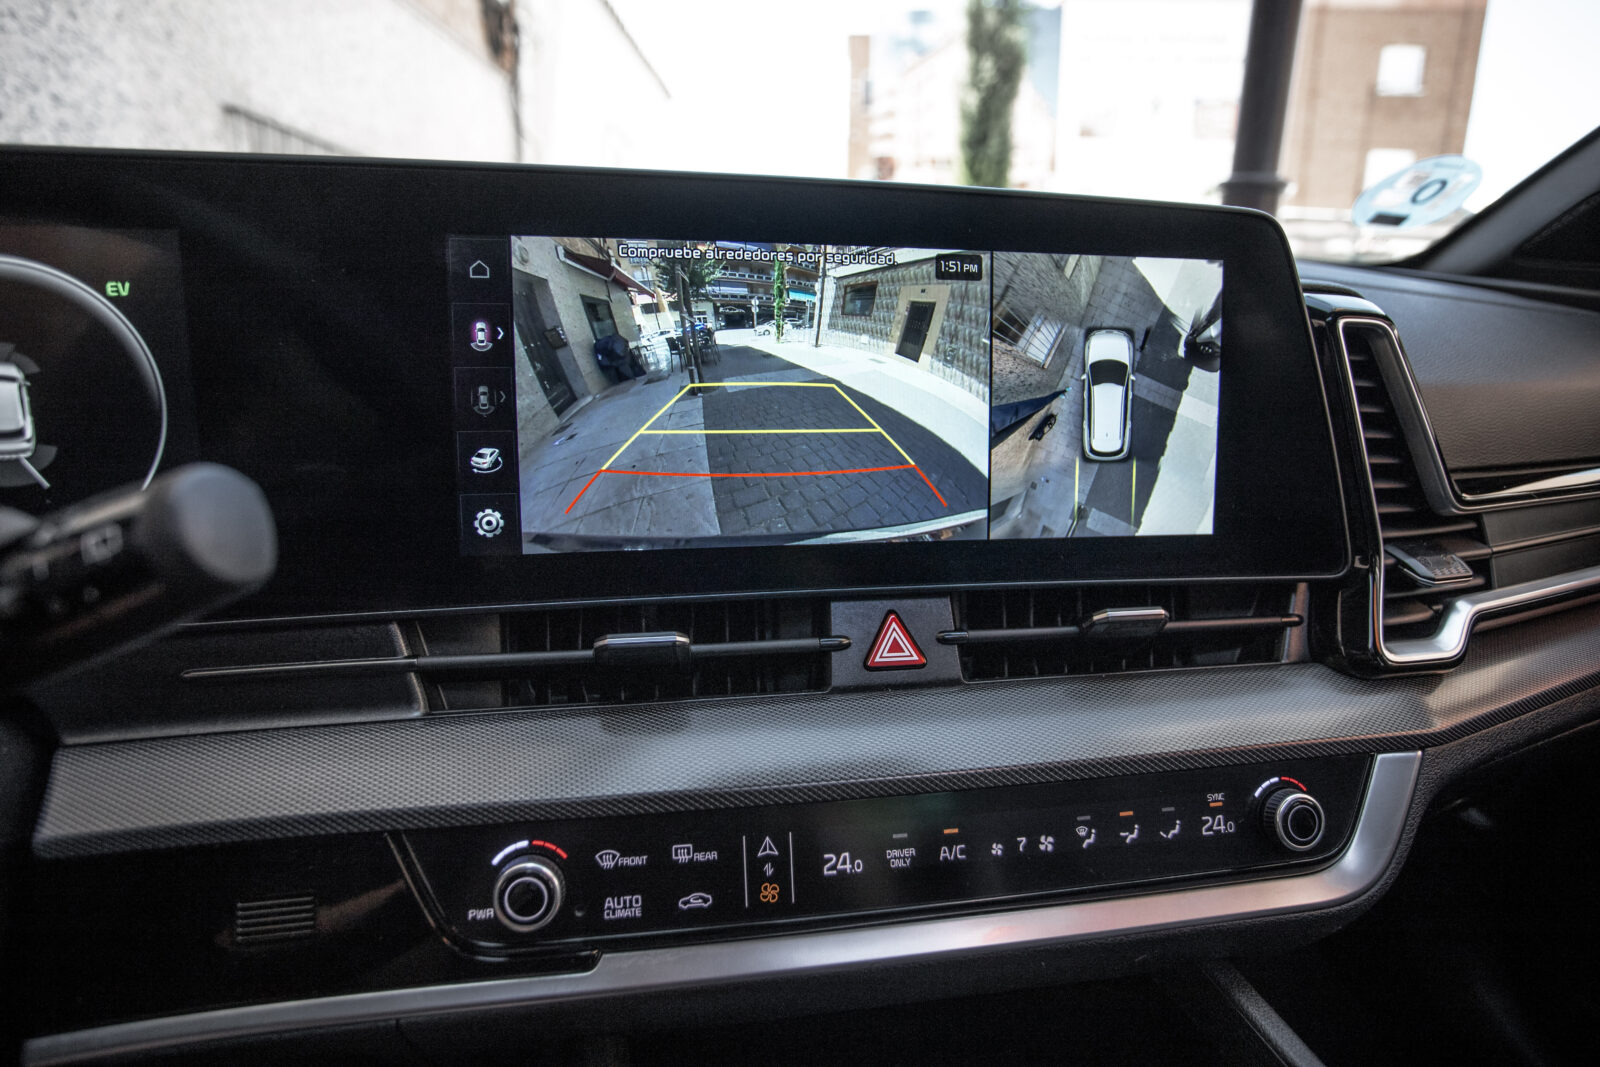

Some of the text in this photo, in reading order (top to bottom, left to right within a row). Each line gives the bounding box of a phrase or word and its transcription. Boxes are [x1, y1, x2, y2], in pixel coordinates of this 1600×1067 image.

[618, 244, 898, 266] Compruebe alrededores por seguridad.
[940, 260, 979, 274] 1:51 PM
[105, 280, 130, 297] EV
[1206, 792, 1225, 802] SYNC
[1201, 814, 1236, 836] 24.0
[1016, 836, 1027, 852] 7
[693, 851, 718, 862] REAR
[886, 847, 916, 859] DRIVER
[939, 844, 966, 862] A/C
[617, 855, 648, 868] FRONT
[823, 851, 863, 876] 24.0
[889, 857, 912, 868] ONLY
[604, 895, 642, 909] AUTO
[467, 908, 495, 921] PWR
[603, 906, 642, 919] CLIMATE
